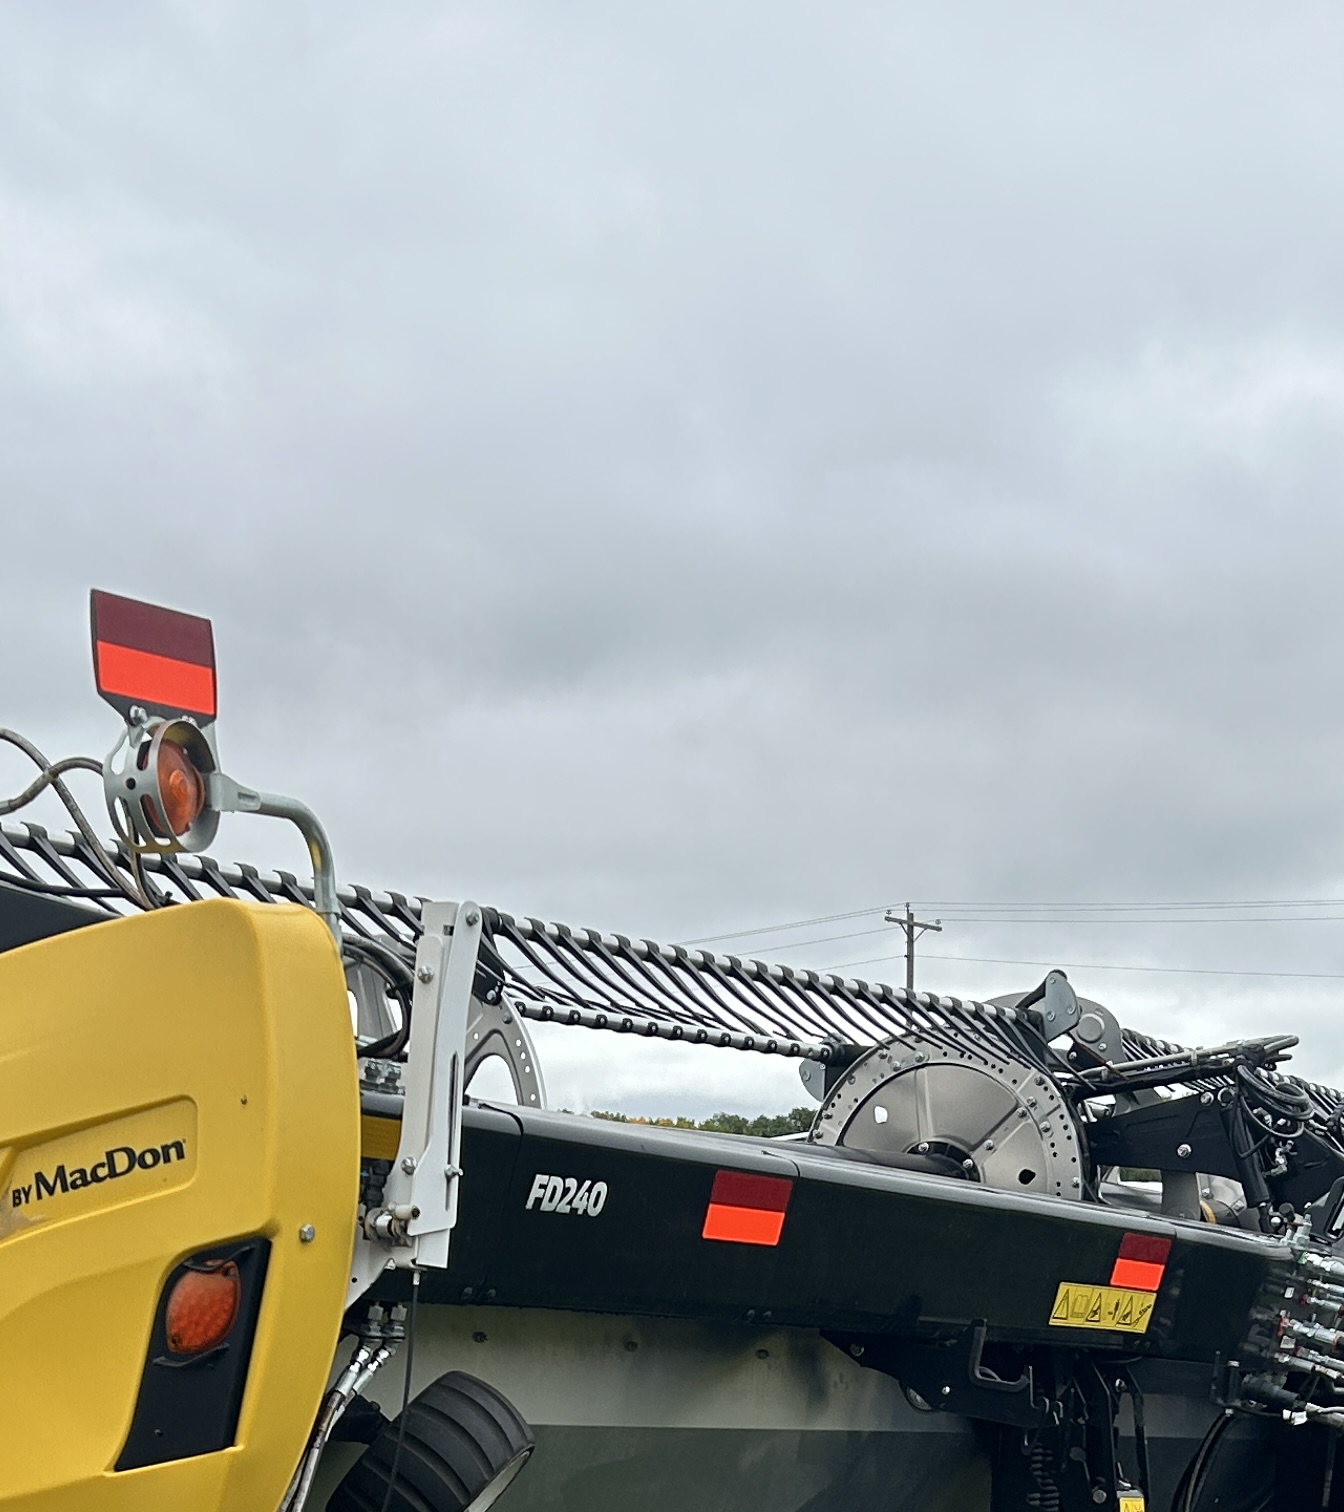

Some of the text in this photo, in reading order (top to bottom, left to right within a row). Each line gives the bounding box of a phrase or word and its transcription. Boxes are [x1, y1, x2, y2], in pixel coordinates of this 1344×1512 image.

[12, 1140, 185, 1207] BY MacDon
[525, 1174, 608, 1217] FD240
